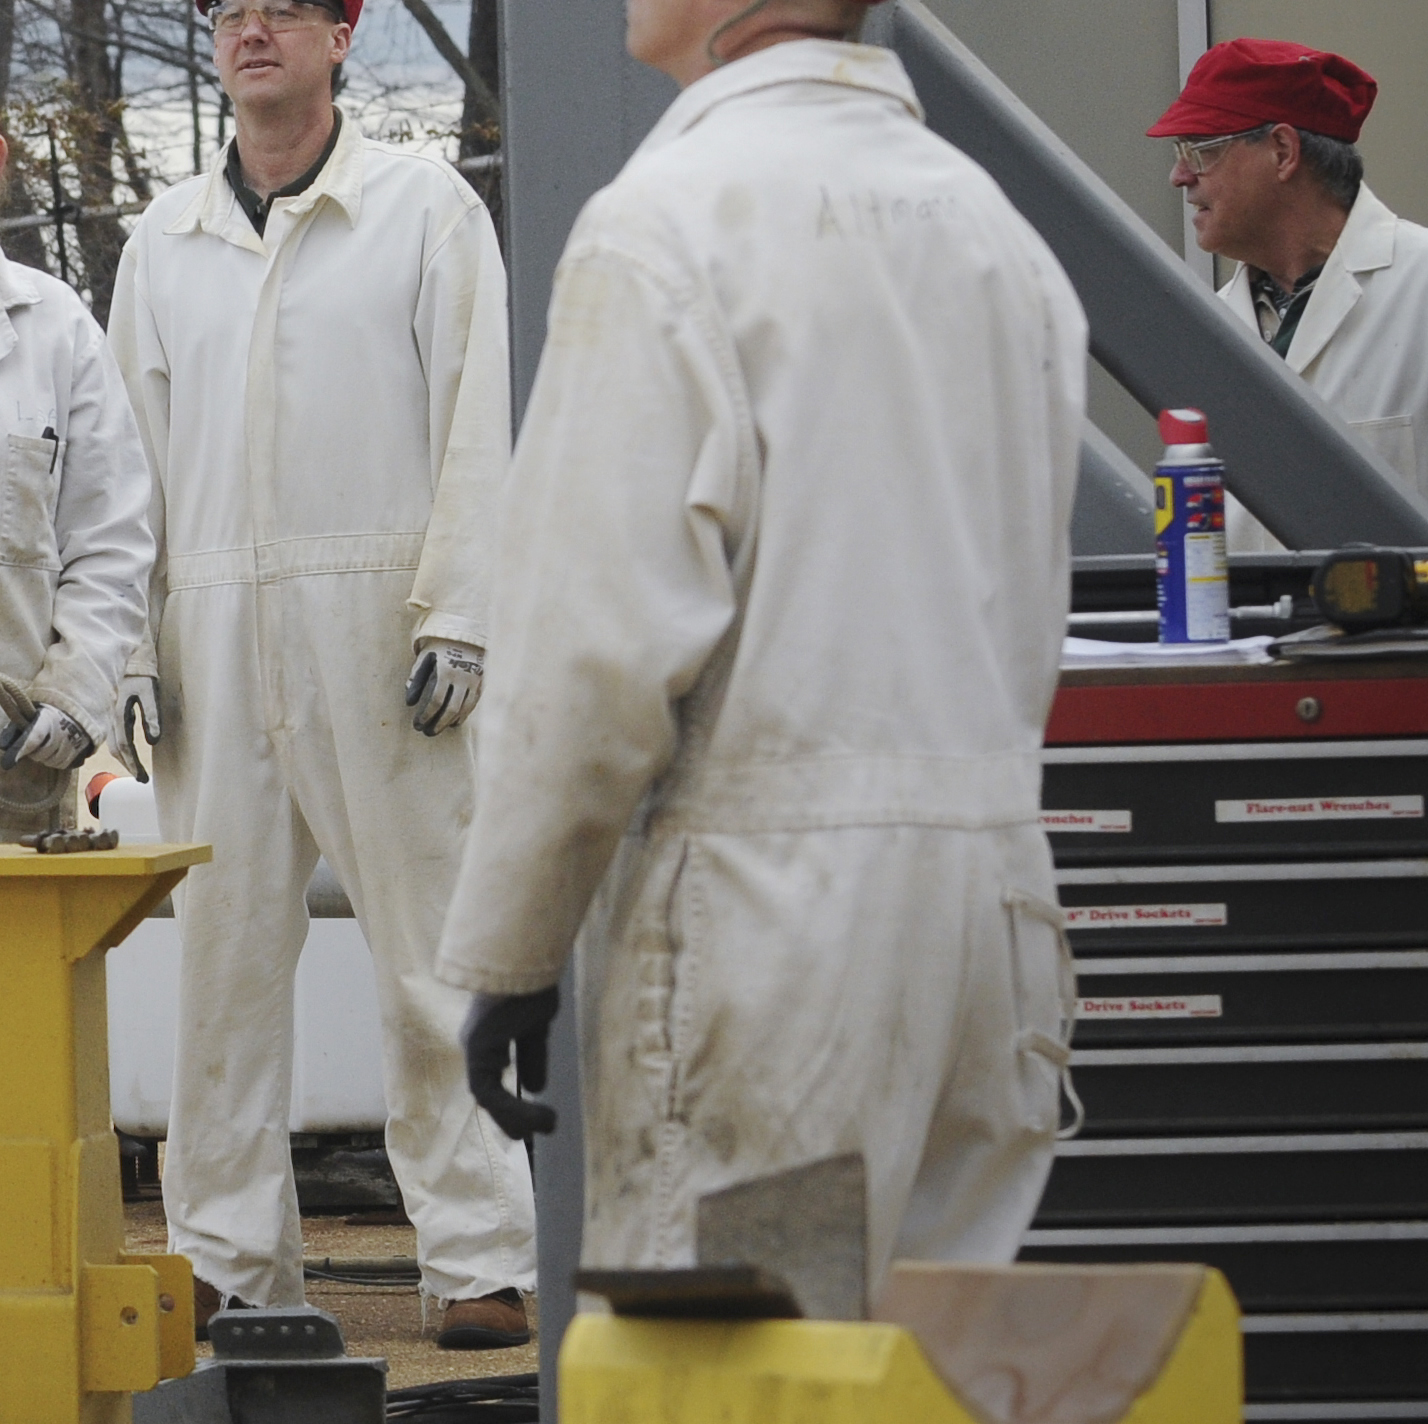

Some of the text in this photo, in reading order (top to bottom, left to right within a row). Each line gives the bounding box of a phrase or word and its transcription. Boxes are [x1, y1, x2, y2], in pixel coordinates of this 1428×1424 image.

[1089, 909, 1129, 921] Drive
[1134, 907, 1192, 919] Sockets
[1084, 999, 1187, 1012] Drive Sockets
